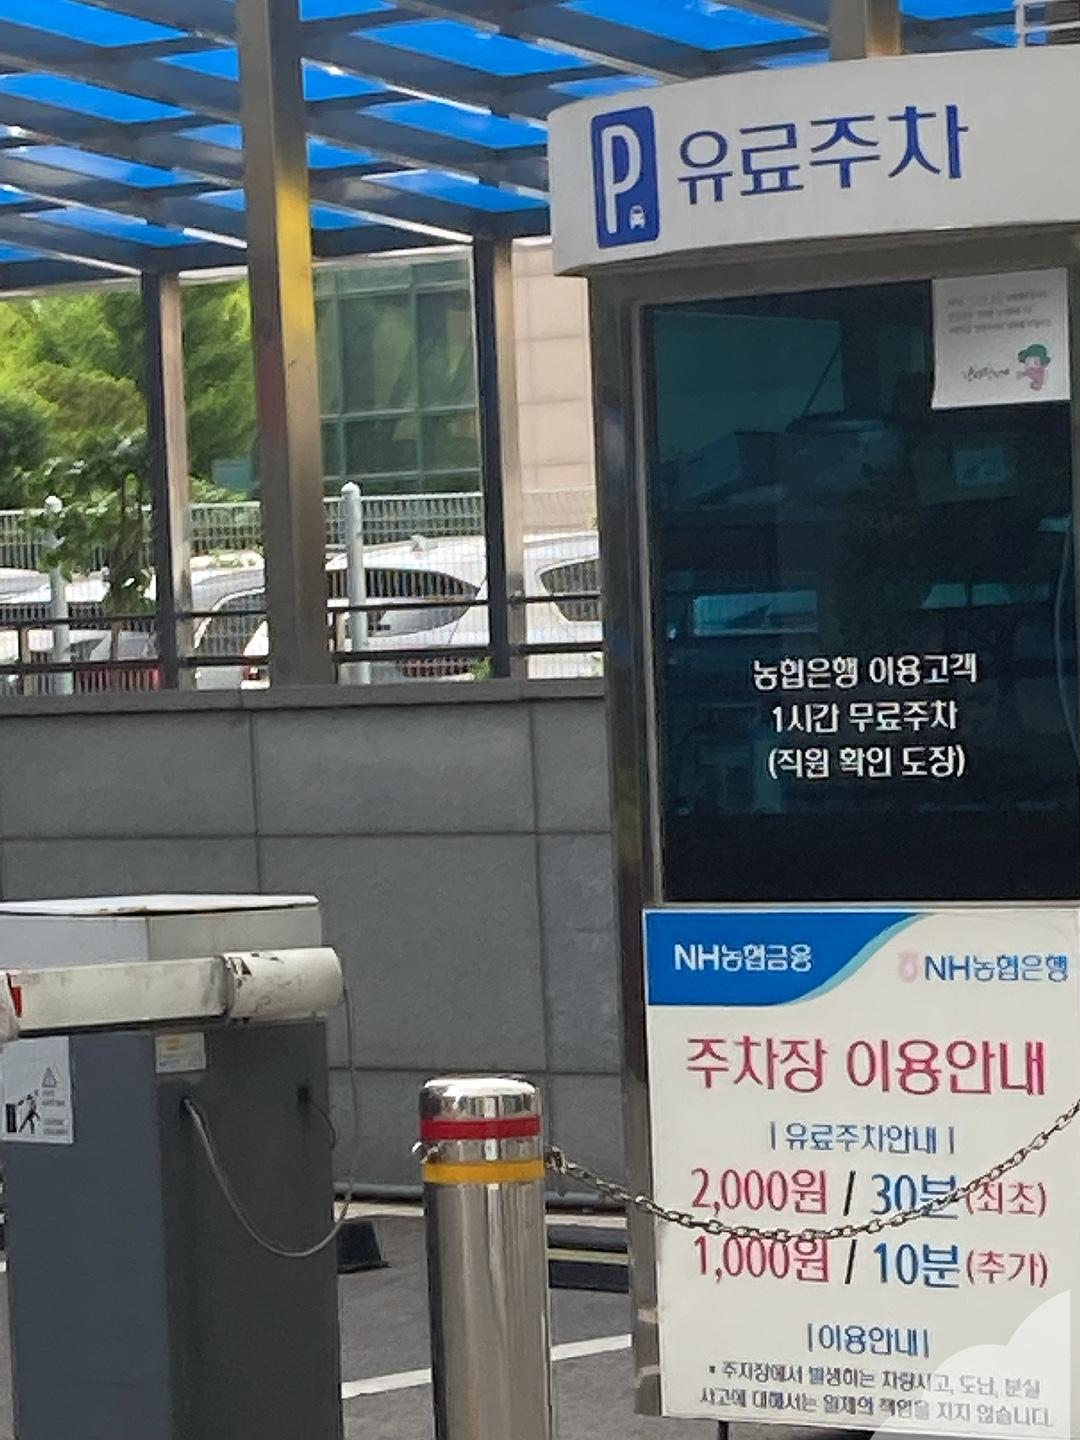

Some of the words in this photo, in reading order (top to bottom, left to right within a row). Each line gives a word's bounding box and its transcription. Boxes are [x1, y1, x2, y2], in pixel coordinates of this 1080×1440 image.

[678, 103, 968, 205] 유료주차
[753, 655, 858, 690] 농협은행
[869, 652, 978, 687] 이용고객
[772, 702, 840, 733] 1시간
[850, 699, 958, 733] 무료주차
[768, 747, 829, 780] (직원
[839, 746, 891, 777] 확인
[902, 744, 966, 778] 도장)
[674, 943, 813, 974] NH농협금융
[924, 952, 1069, 984] NH농협은행
[686, 1035, 828, 1094] 주차장
[847, 1037, 1046, 1097] 이용안내
[690, 1168, 828, 1217] 2,000원
[694, 1235, 830, 1284] 1,000원
